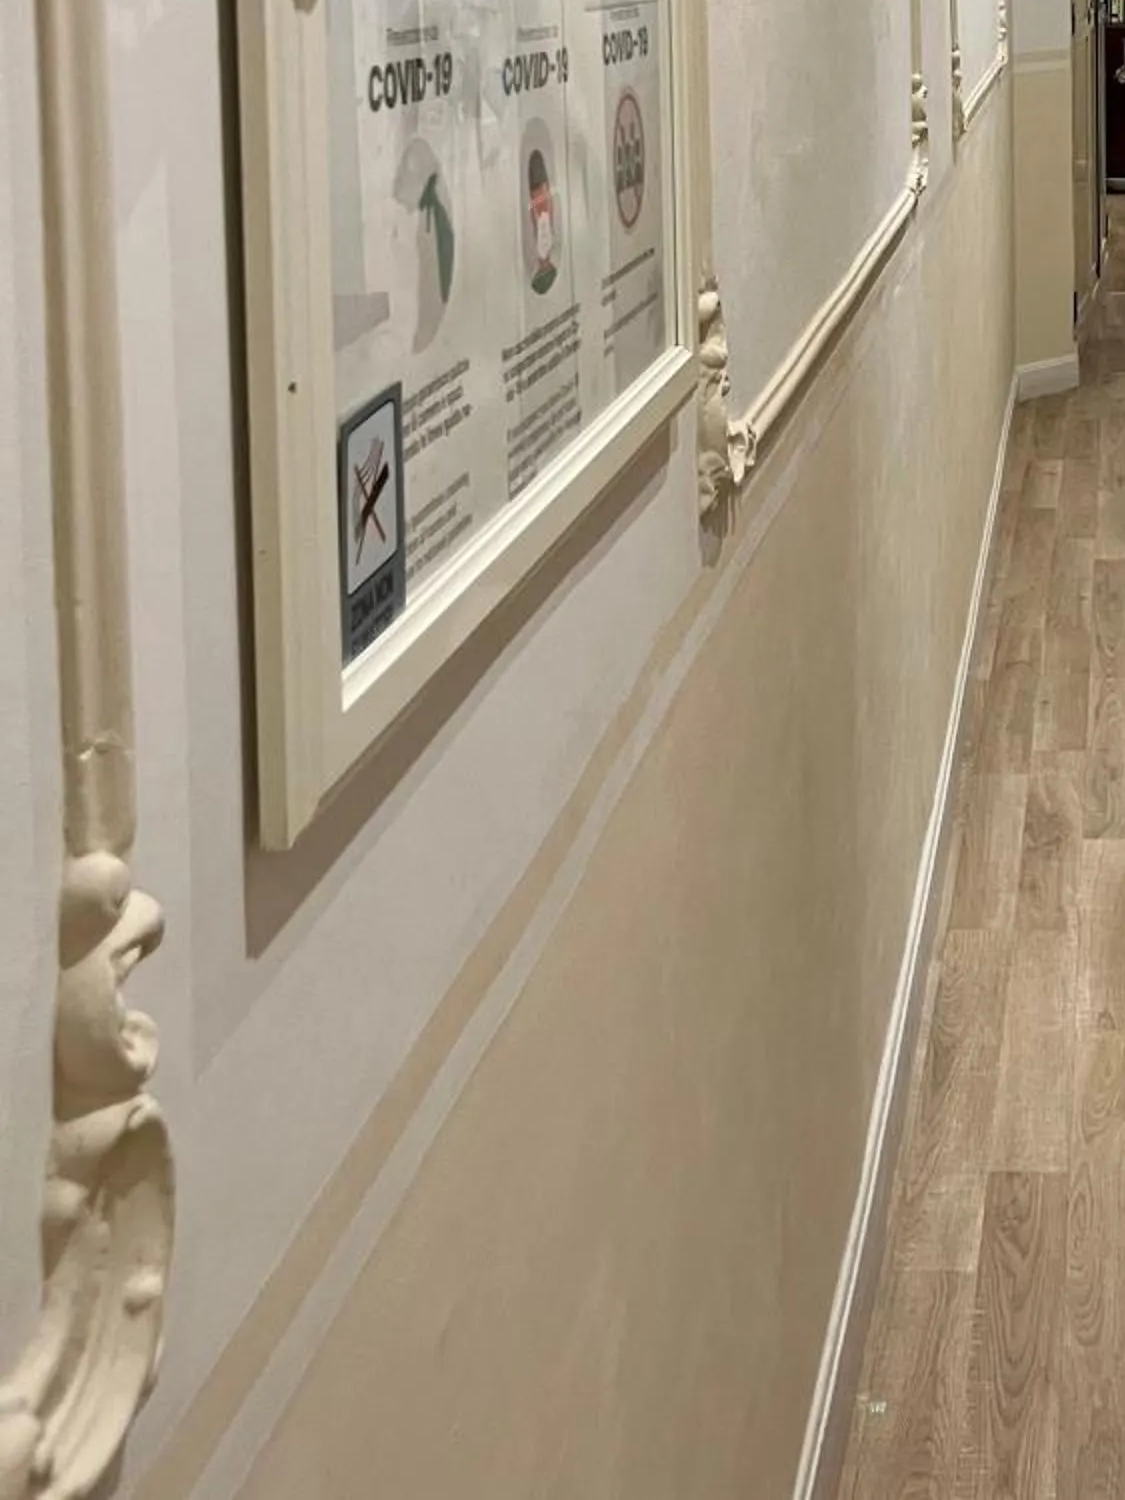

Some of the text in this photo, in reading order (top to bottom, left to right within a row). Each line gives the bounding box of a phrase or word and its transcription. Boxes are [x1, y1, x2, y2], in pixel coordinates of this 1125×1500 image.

[603, 26, 649, 66] COVID-19
[368, 52, 452, 112] COVID-19
[502, 47, 568, 97] COVID-19
